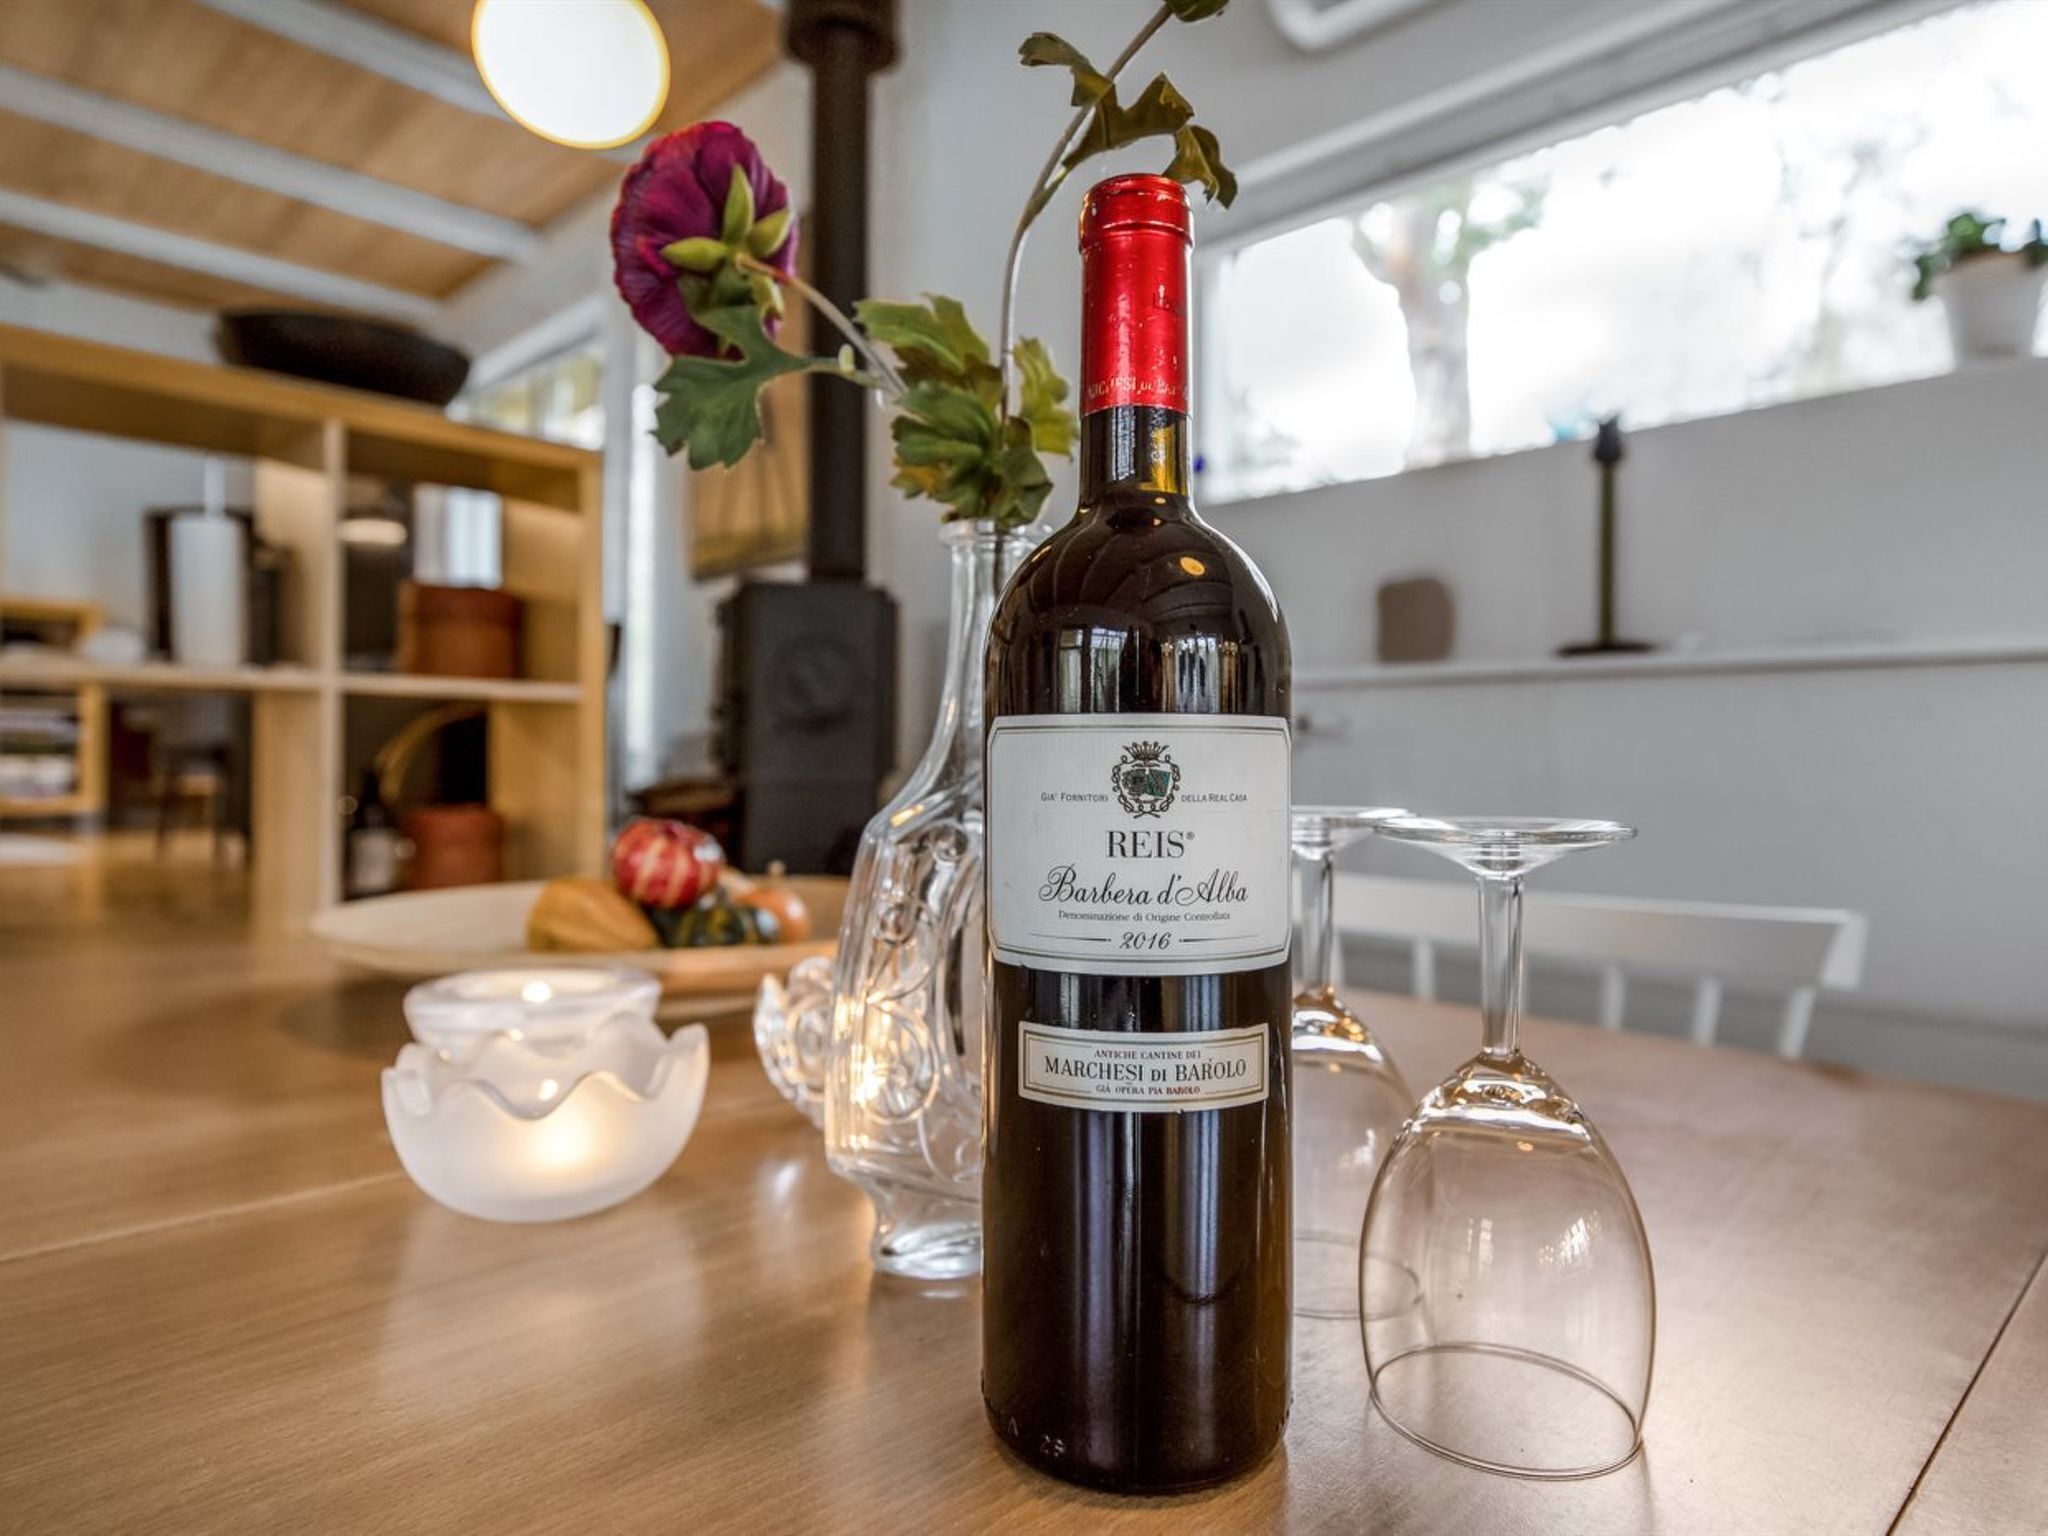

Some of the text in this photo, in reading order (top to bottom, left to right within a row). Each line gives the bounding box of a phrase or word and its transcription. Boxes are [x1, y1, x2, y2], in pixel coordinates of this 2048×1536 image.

[1038, 863, 1248, 906] Barbera d'Alba
[1058, 909, 1130, 922] Denominazione
[1133, 911, 1143, 921] di
[1146, 912, 1180, 923] Origine
[1119, 931, 1172, 950] 2016
[1094, 1050, 1137, 1060] ANTICHE
[1141, 1051, 1182, 1060] CANTINE
[1045, 1055, 1143, 1082] MARCHESI
[1175, 1058, 1246, 1081] BAROLO
[1148, 1086, 1163, 1095] PIA
[1166, 1087, 1200, 1095] BAROLO
